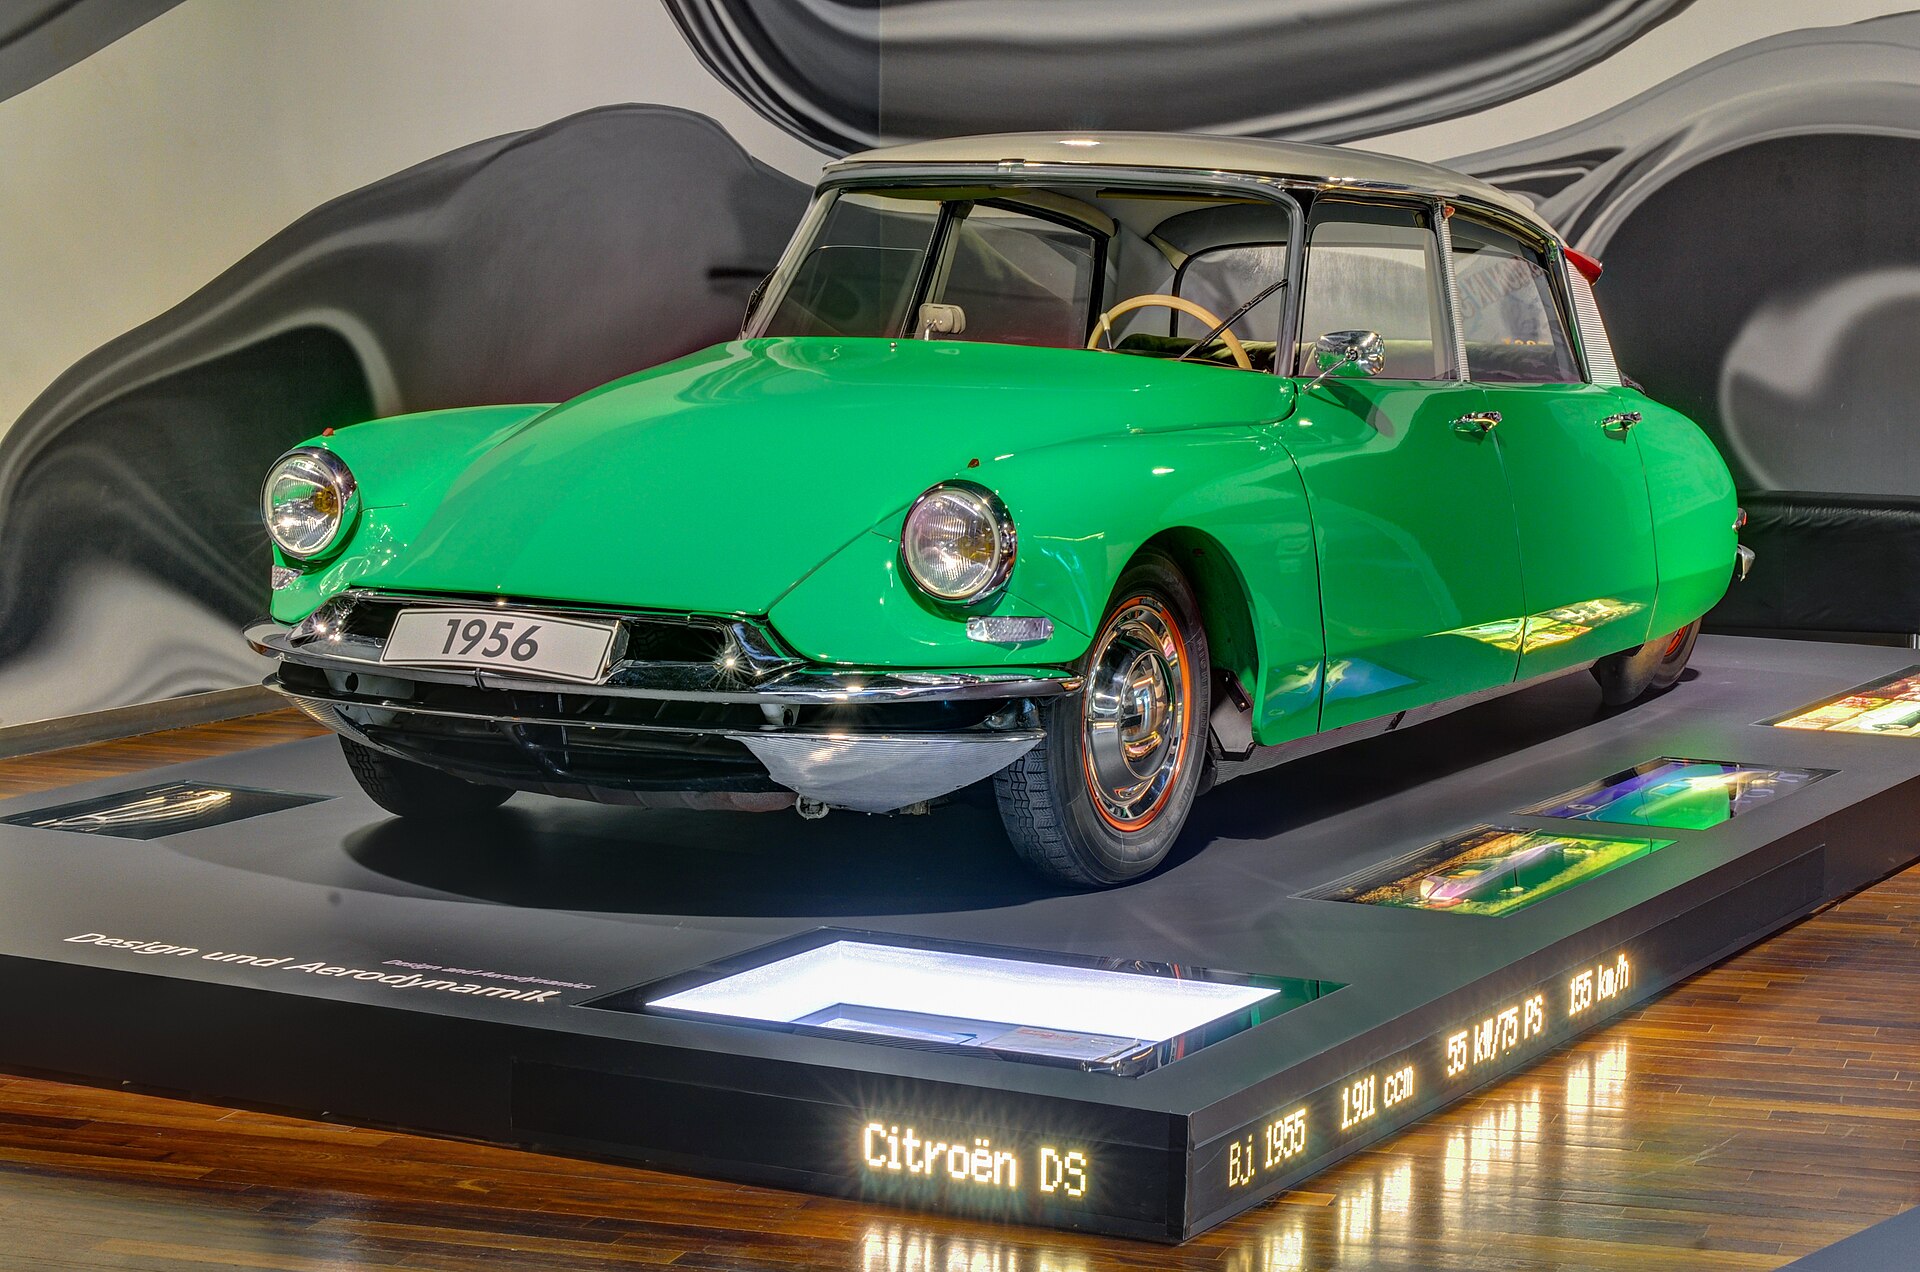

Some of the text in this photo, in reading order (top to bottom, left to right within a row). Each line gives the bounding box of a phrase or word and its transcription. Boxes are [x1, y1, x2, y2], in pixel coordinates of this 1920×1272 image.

[441, 619, 542, 662] 1956
[63, 933, 561, 1003] Design und Aerodynamik
[1265, 1108, 1306, 1169] 1955
[1341, 1075, 1376, 1131] 1.911
[1383, 1066, 1414, 1108] ccm
[1447, 1030, 1468, 1078] 55
[1523, 994, 1543, 1040] PS
[1569, 970, 1592, 1017] 155
[1597, 953, 1629, 1002] km/h
[864, 1123, 1087, 1197] Citroën DS
